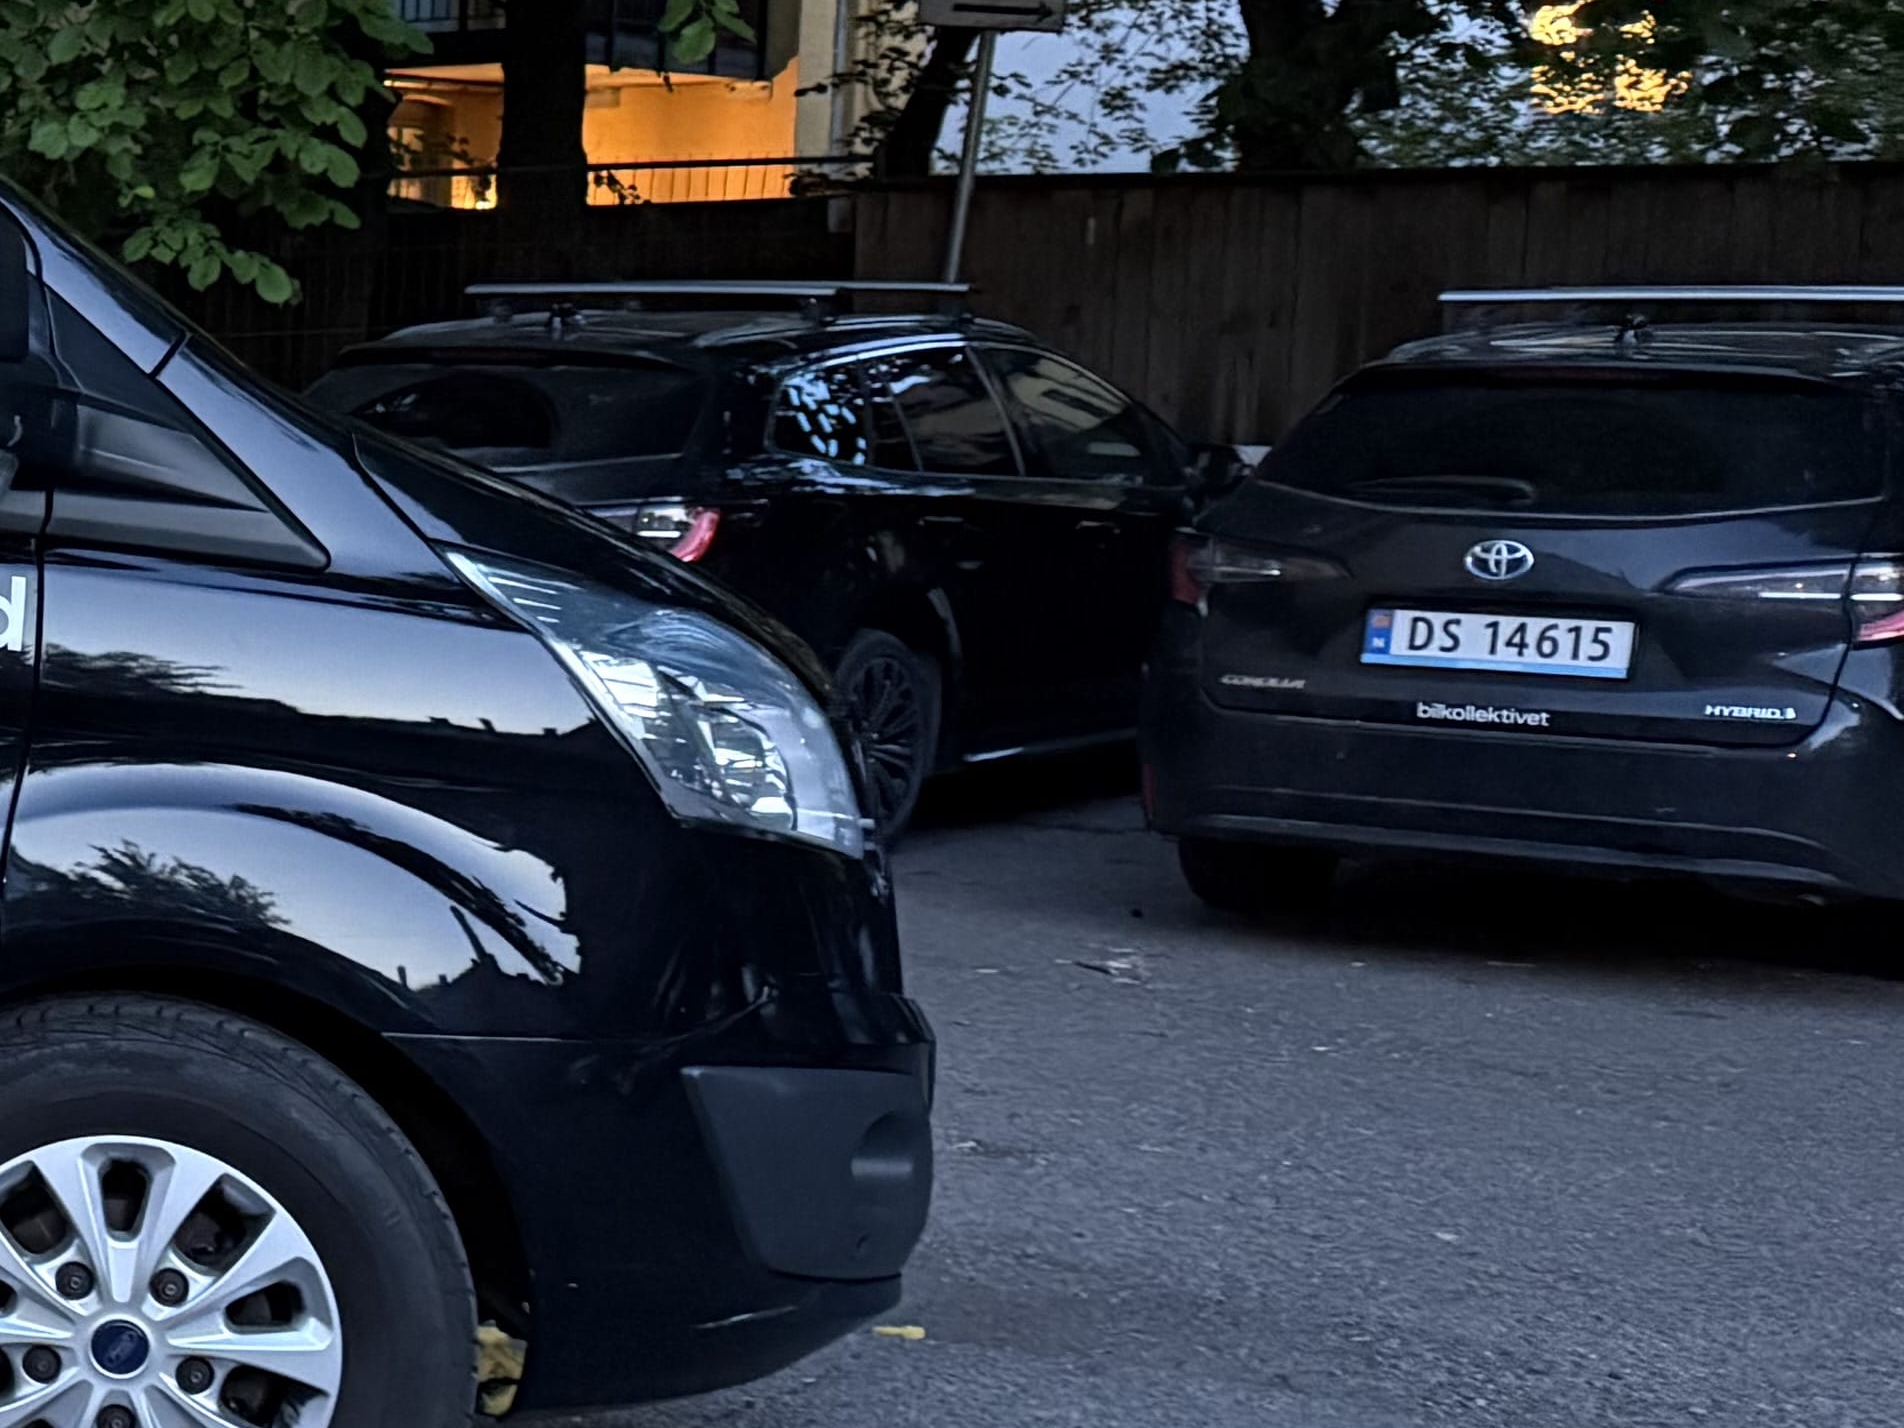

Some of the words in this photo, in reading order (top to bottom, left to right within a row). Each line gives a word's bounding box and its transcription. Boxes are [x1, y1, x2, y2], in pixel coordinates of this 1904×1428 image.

[1407, 615, 1463, 654] DS
[1483, 620, 1614, 663] 14615
[1416, 701, 1552, 727] bilkollektivet
